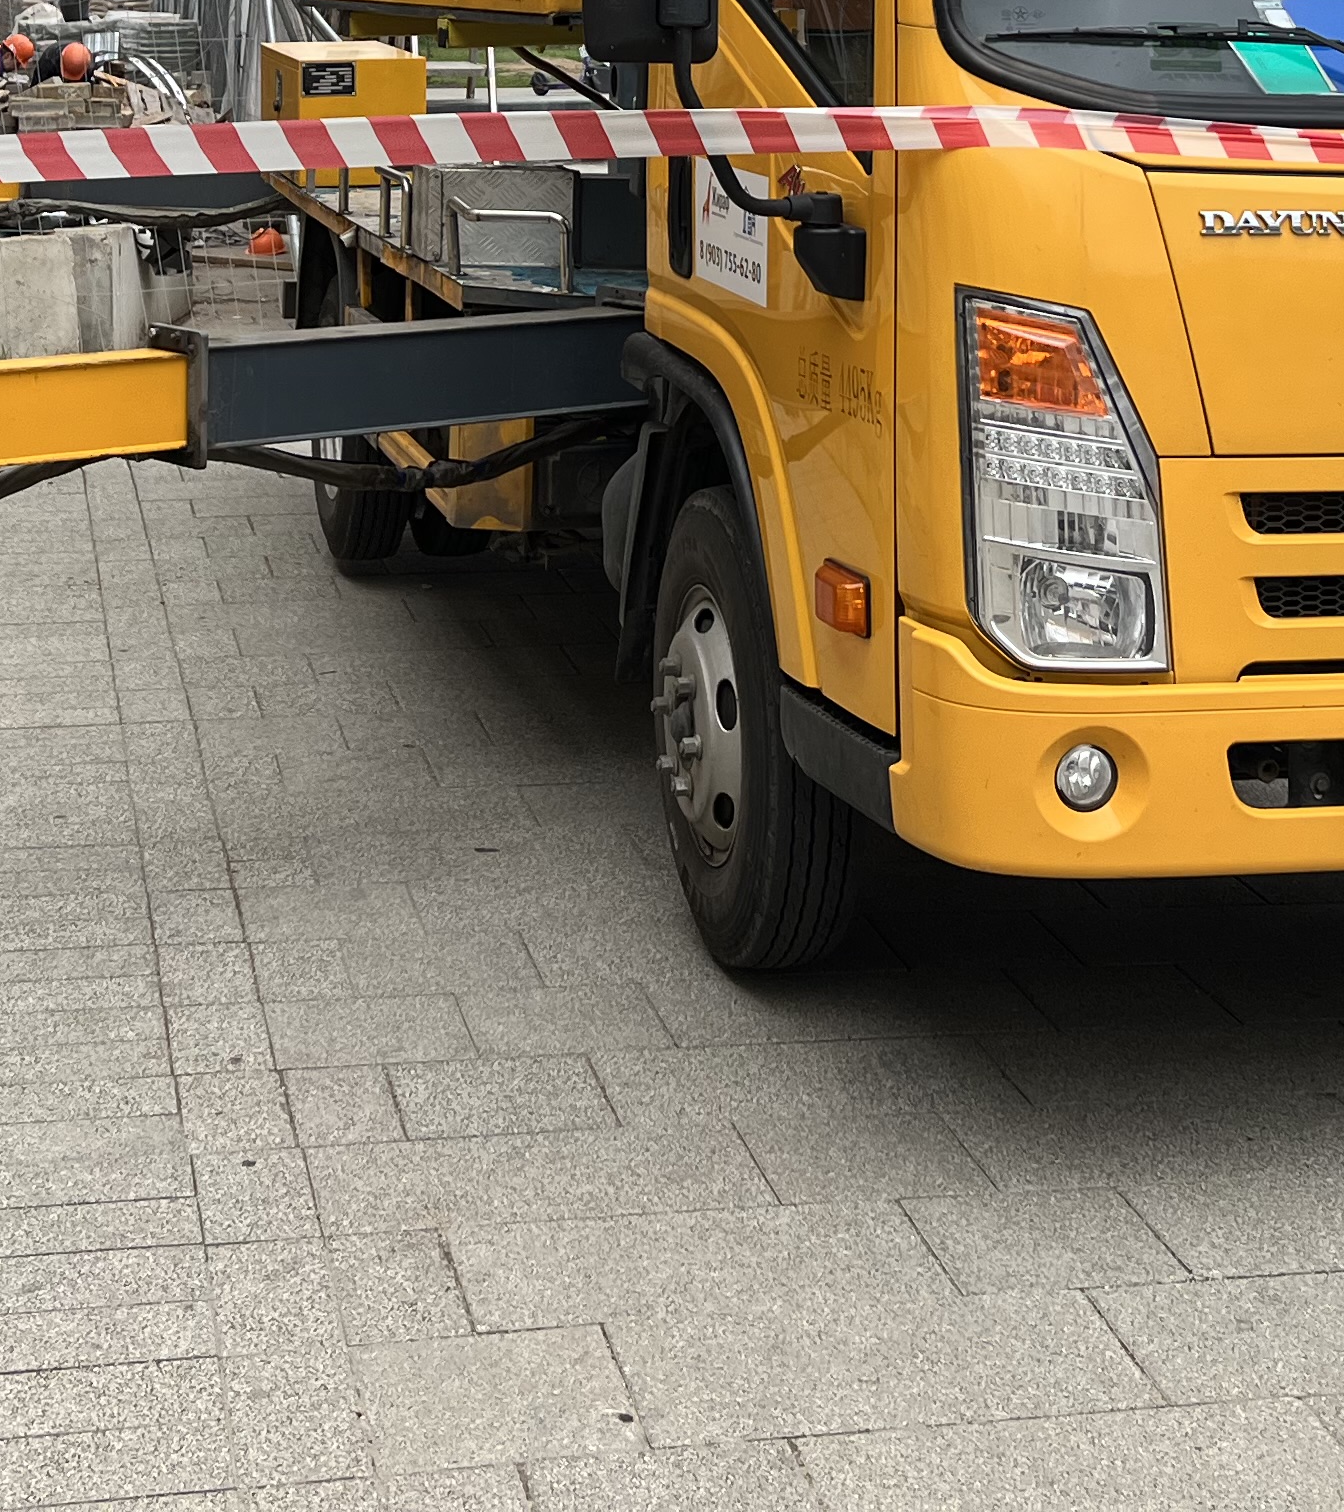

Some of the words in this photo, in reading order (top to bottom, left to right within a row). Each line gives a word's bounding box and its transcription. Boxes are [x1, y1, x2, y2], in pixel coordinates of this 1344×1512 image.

[699, 239, 705, 260] 8
[705, 241, 723, 273] (903)
[723, 248, 762, 285] 755-62-80
